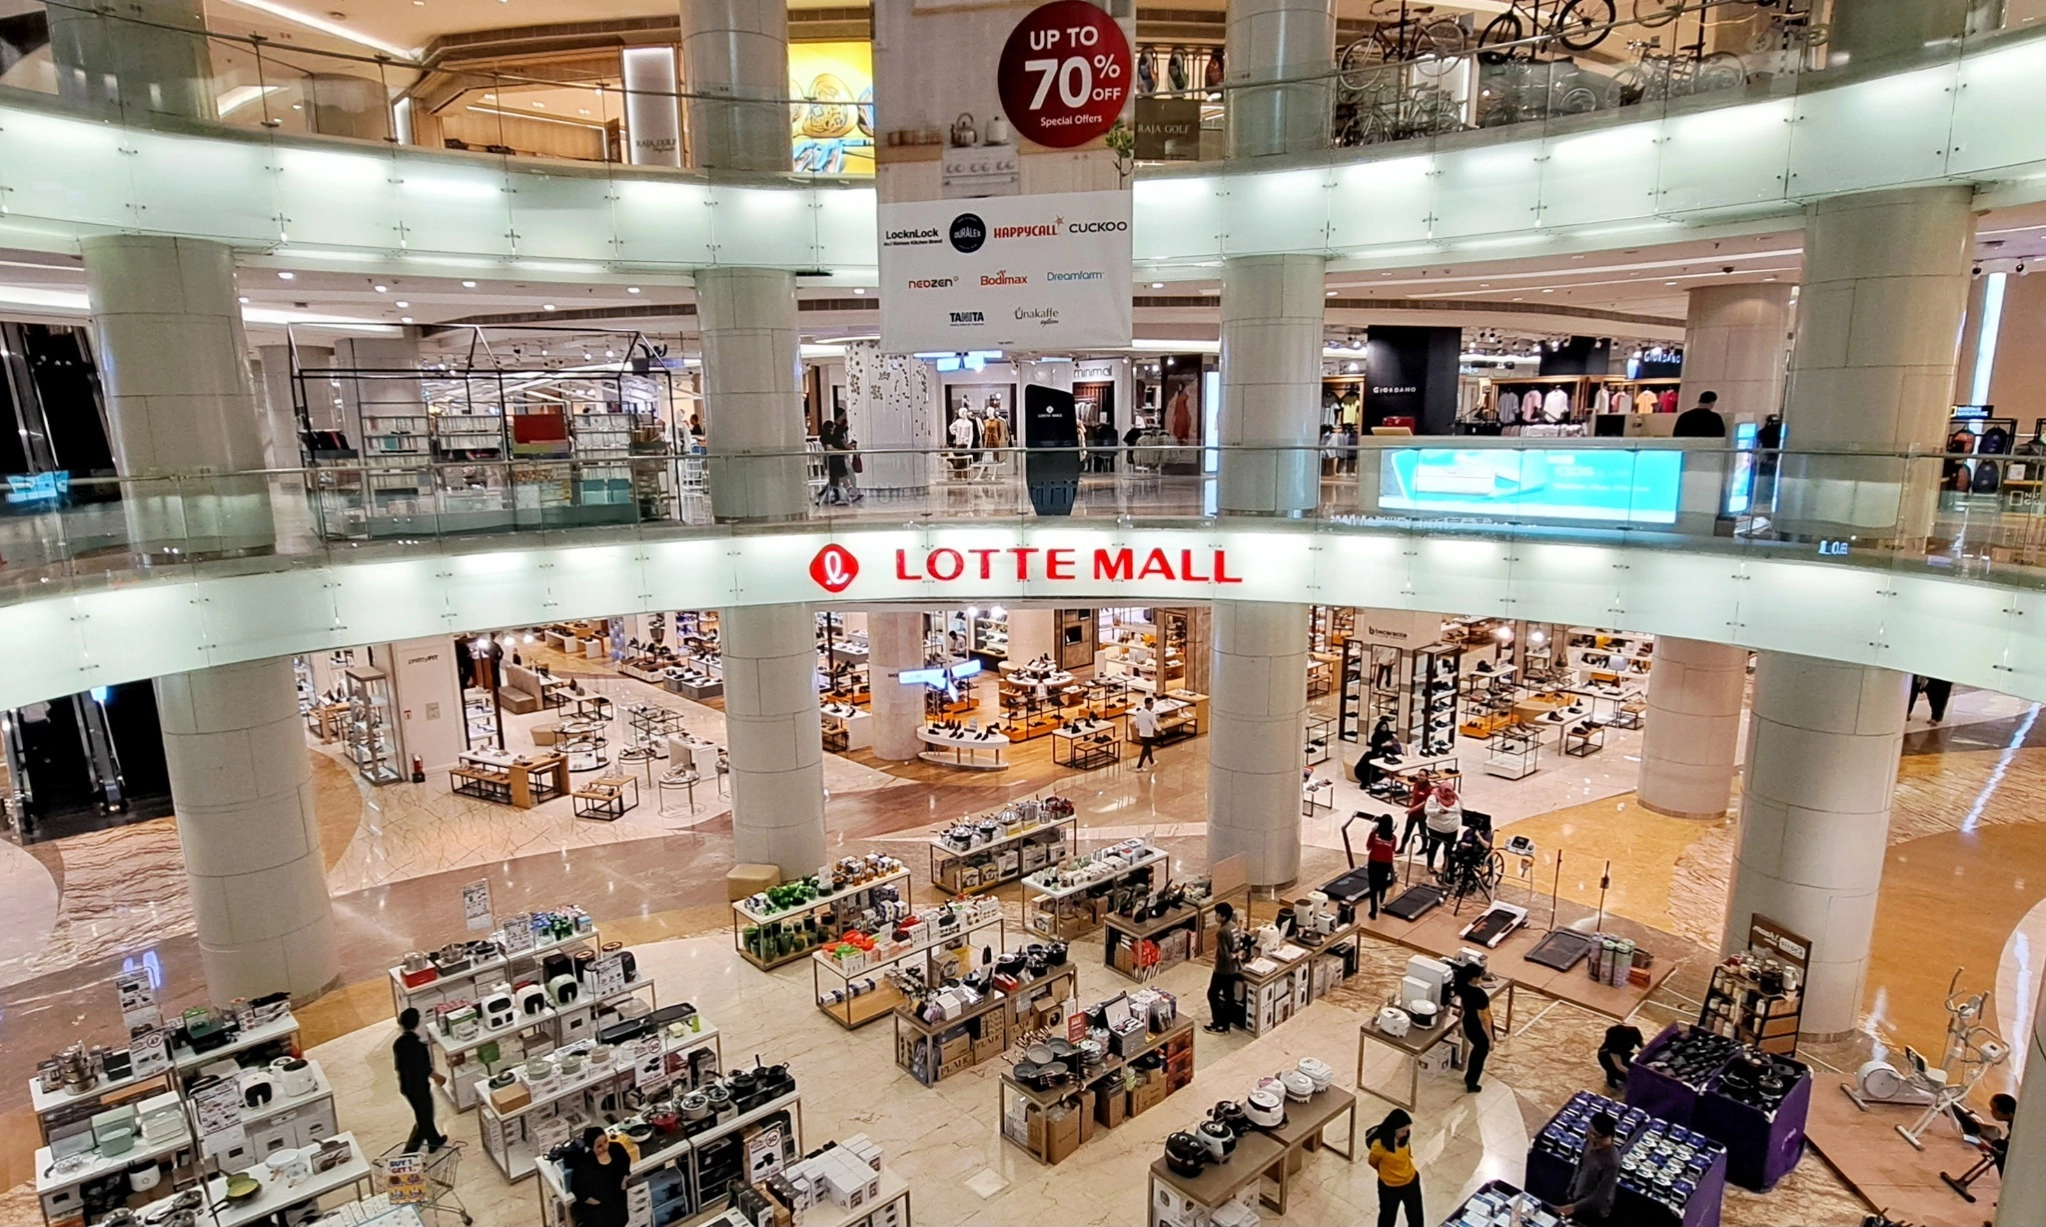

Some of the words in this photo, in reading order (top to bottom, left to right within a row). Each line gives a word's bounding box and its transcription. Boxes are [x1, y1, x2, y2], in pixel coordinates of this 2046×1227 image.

[1029, 29, 1060, 51] UP
[1066, 25, 1099, 48] TO
[1092, 87, 1121, 101] OFF
[1040, 115, 1073, 128] Special
[1074, 114, 1102, 125] Offers
[1137, 123, 1162, 135] RAJA
[1164, 124, 1190, 135] GOLF
[885, 227, 940, 240] LocknLock
[993, 224, 1058, 239] HAPPYCALL
[1068, 221, 1128, 233] CUCKOO
[980, 273, 1028, 286] Bodimax
[1047, 271, 1103, 282] Dreamfarm
[949, 311, 985, 323] TANITA
[1372, 386, 1417, 394] GIORDANO
[895, 547, 1075, 581] LOTTE
[1093, 547, 1243, 584] MALL
